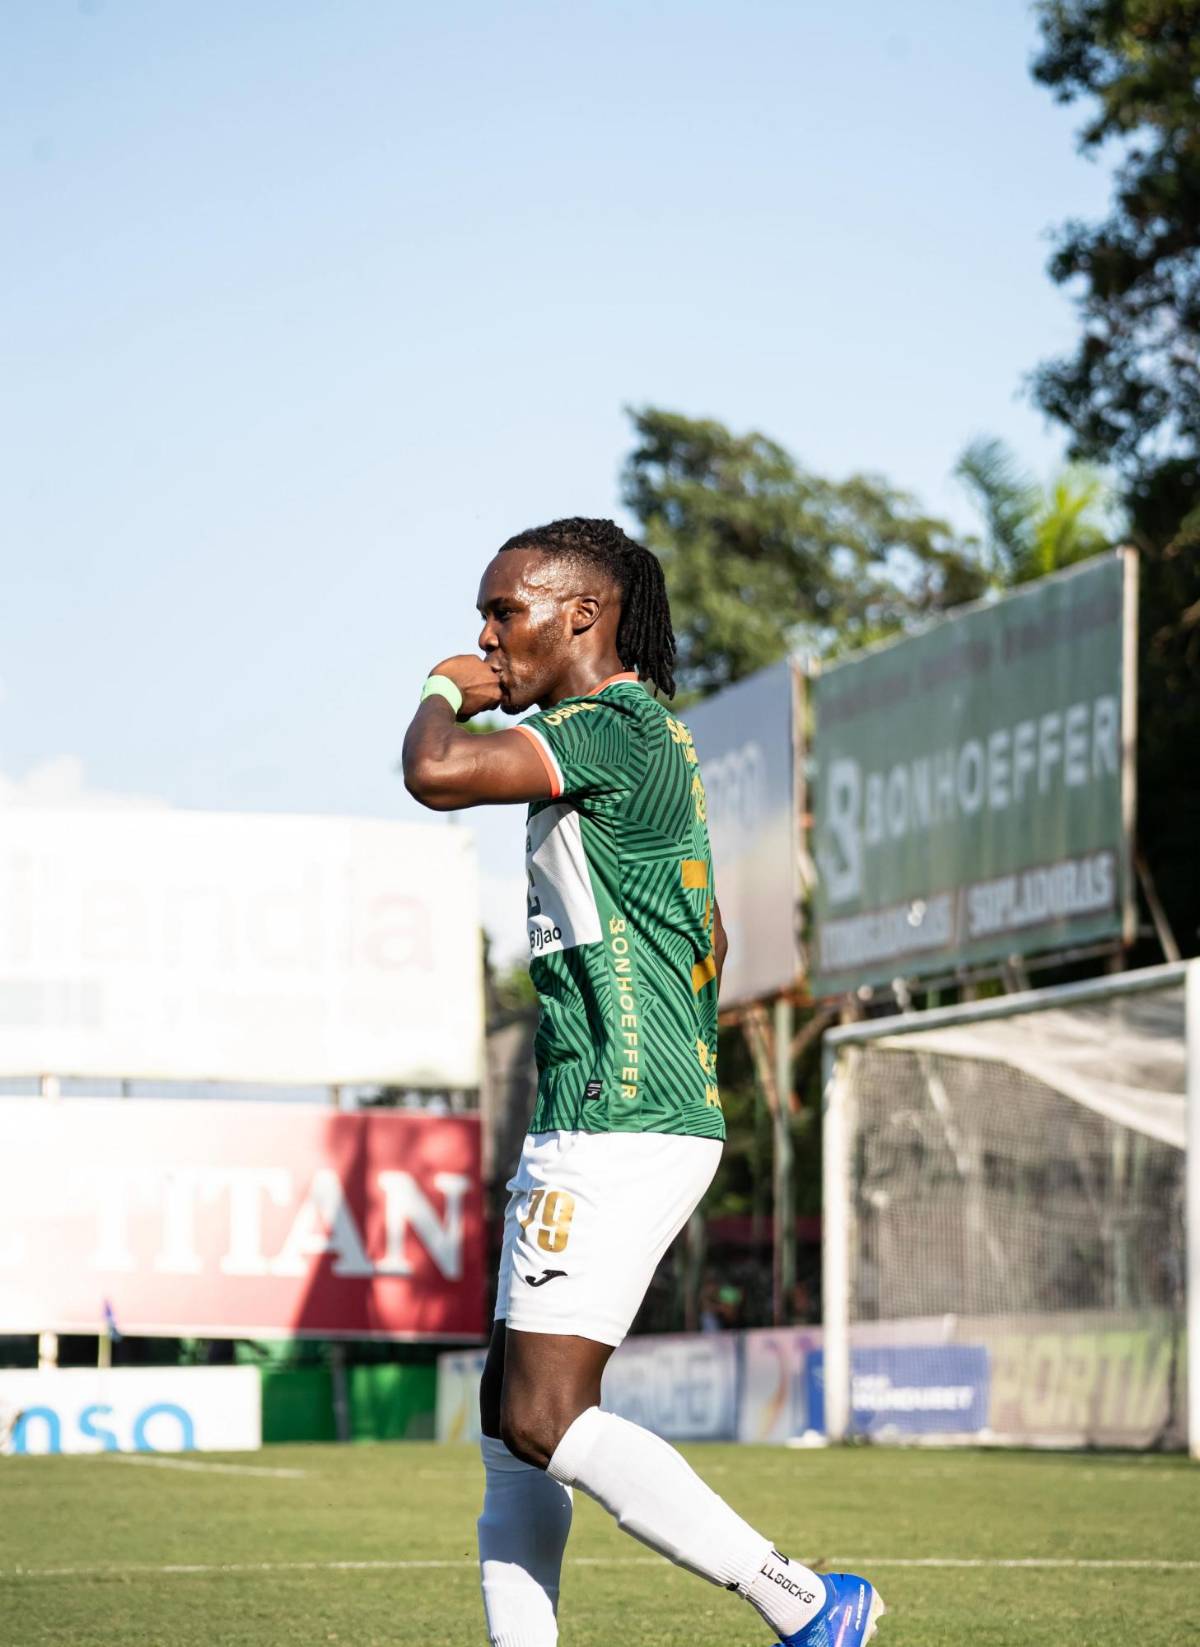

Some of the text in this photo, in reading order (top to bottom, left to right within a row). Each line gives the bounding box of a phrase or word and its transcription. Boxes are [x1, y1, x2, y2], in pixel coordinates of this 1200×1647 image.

[865, 694, 1118, 847] BONHOEFFER
[608, 914, 640, 1100] BONHOEFFER
[66, 1167, 472, 1281] TITAN
[520, 1189, 576, 1253] 79
